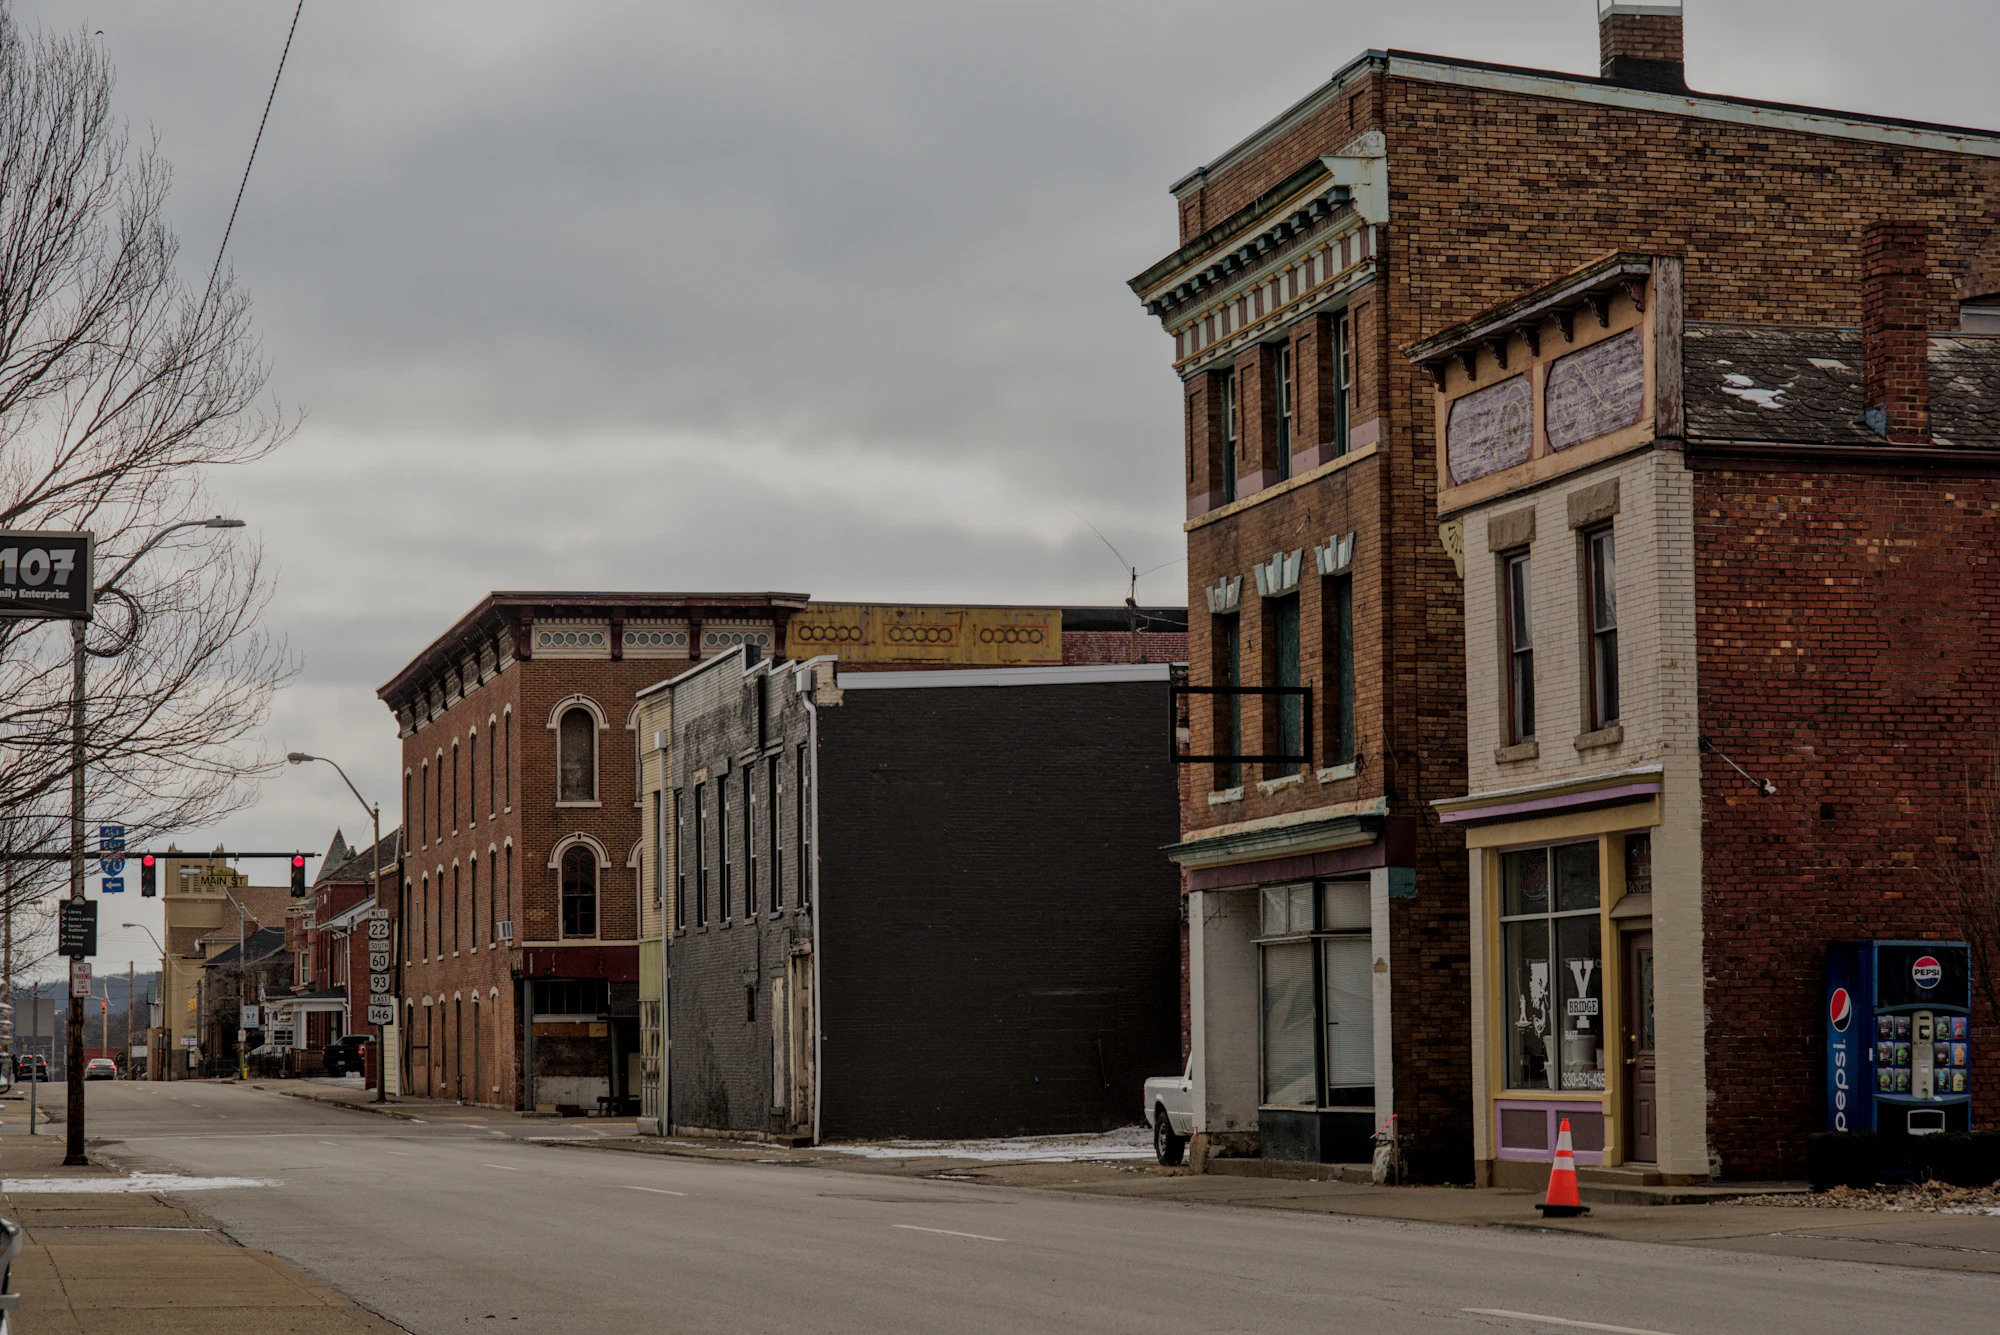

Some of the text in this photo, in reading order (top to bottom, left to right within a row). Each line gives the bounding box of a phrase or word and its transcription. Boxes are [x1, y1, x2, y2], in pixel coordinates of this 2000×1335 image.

[19, 588, 70, 600] Enterprise
[103, 859, 122, 872] 70
[201, 877, 246, 885] MAIN ST.
[372, 924, 386, 935] 22
[372, 955, 385, 966] 60
[373, 977, 386, 987] 93
[1568, 1001, 1597, 1013] BRIDGE
[371, 1010, 388, 1019] 146
